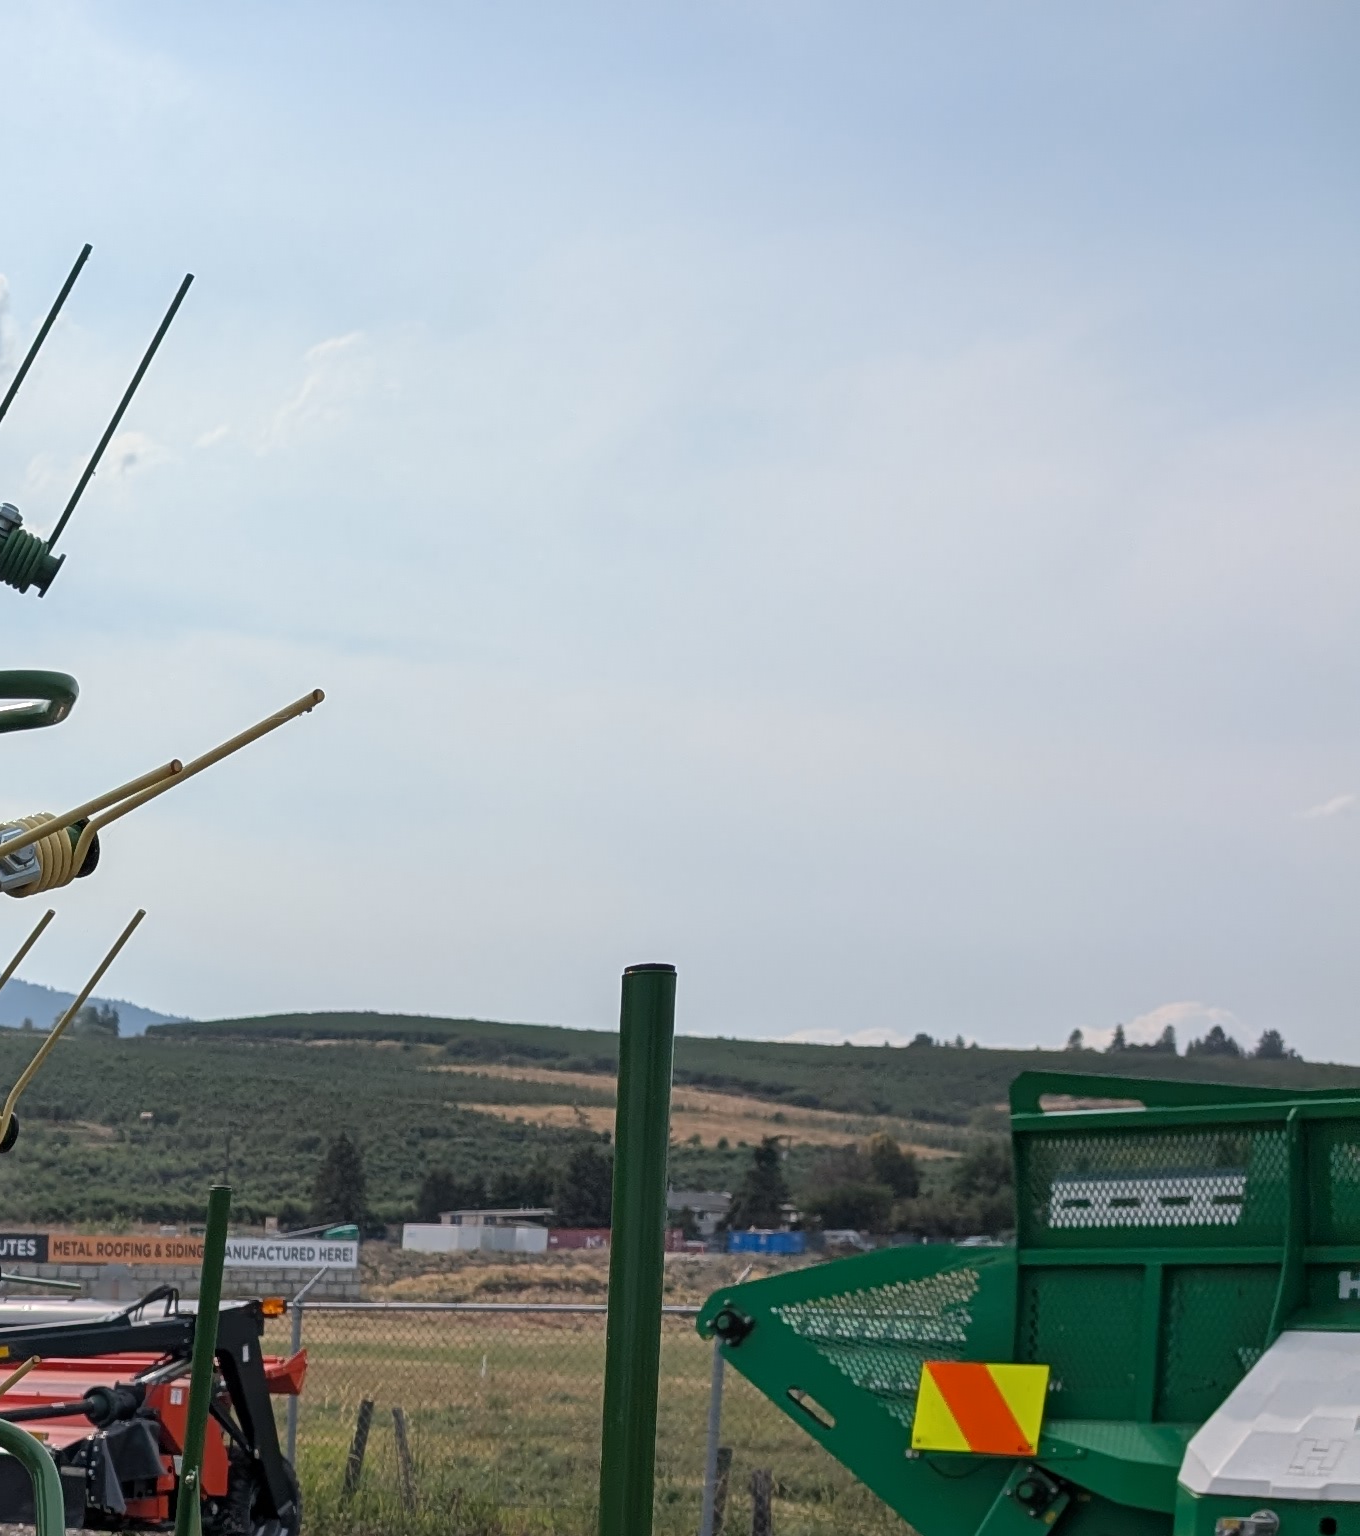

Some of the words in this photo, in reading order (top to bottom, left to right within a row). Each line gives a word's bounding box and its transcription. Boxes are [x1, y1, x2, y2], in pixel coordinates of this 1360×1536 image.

[53, 1241, 92, 1256] METAL
[96, 1243, 151, 1257] ROOFING
[154, 1244, 162, 1258] &
[165, 1244, 204, 1258] SIDING
[225, 1245, 315, 1261] ANUFACTURED
[319, 1247, 353, 1262] HERE!
